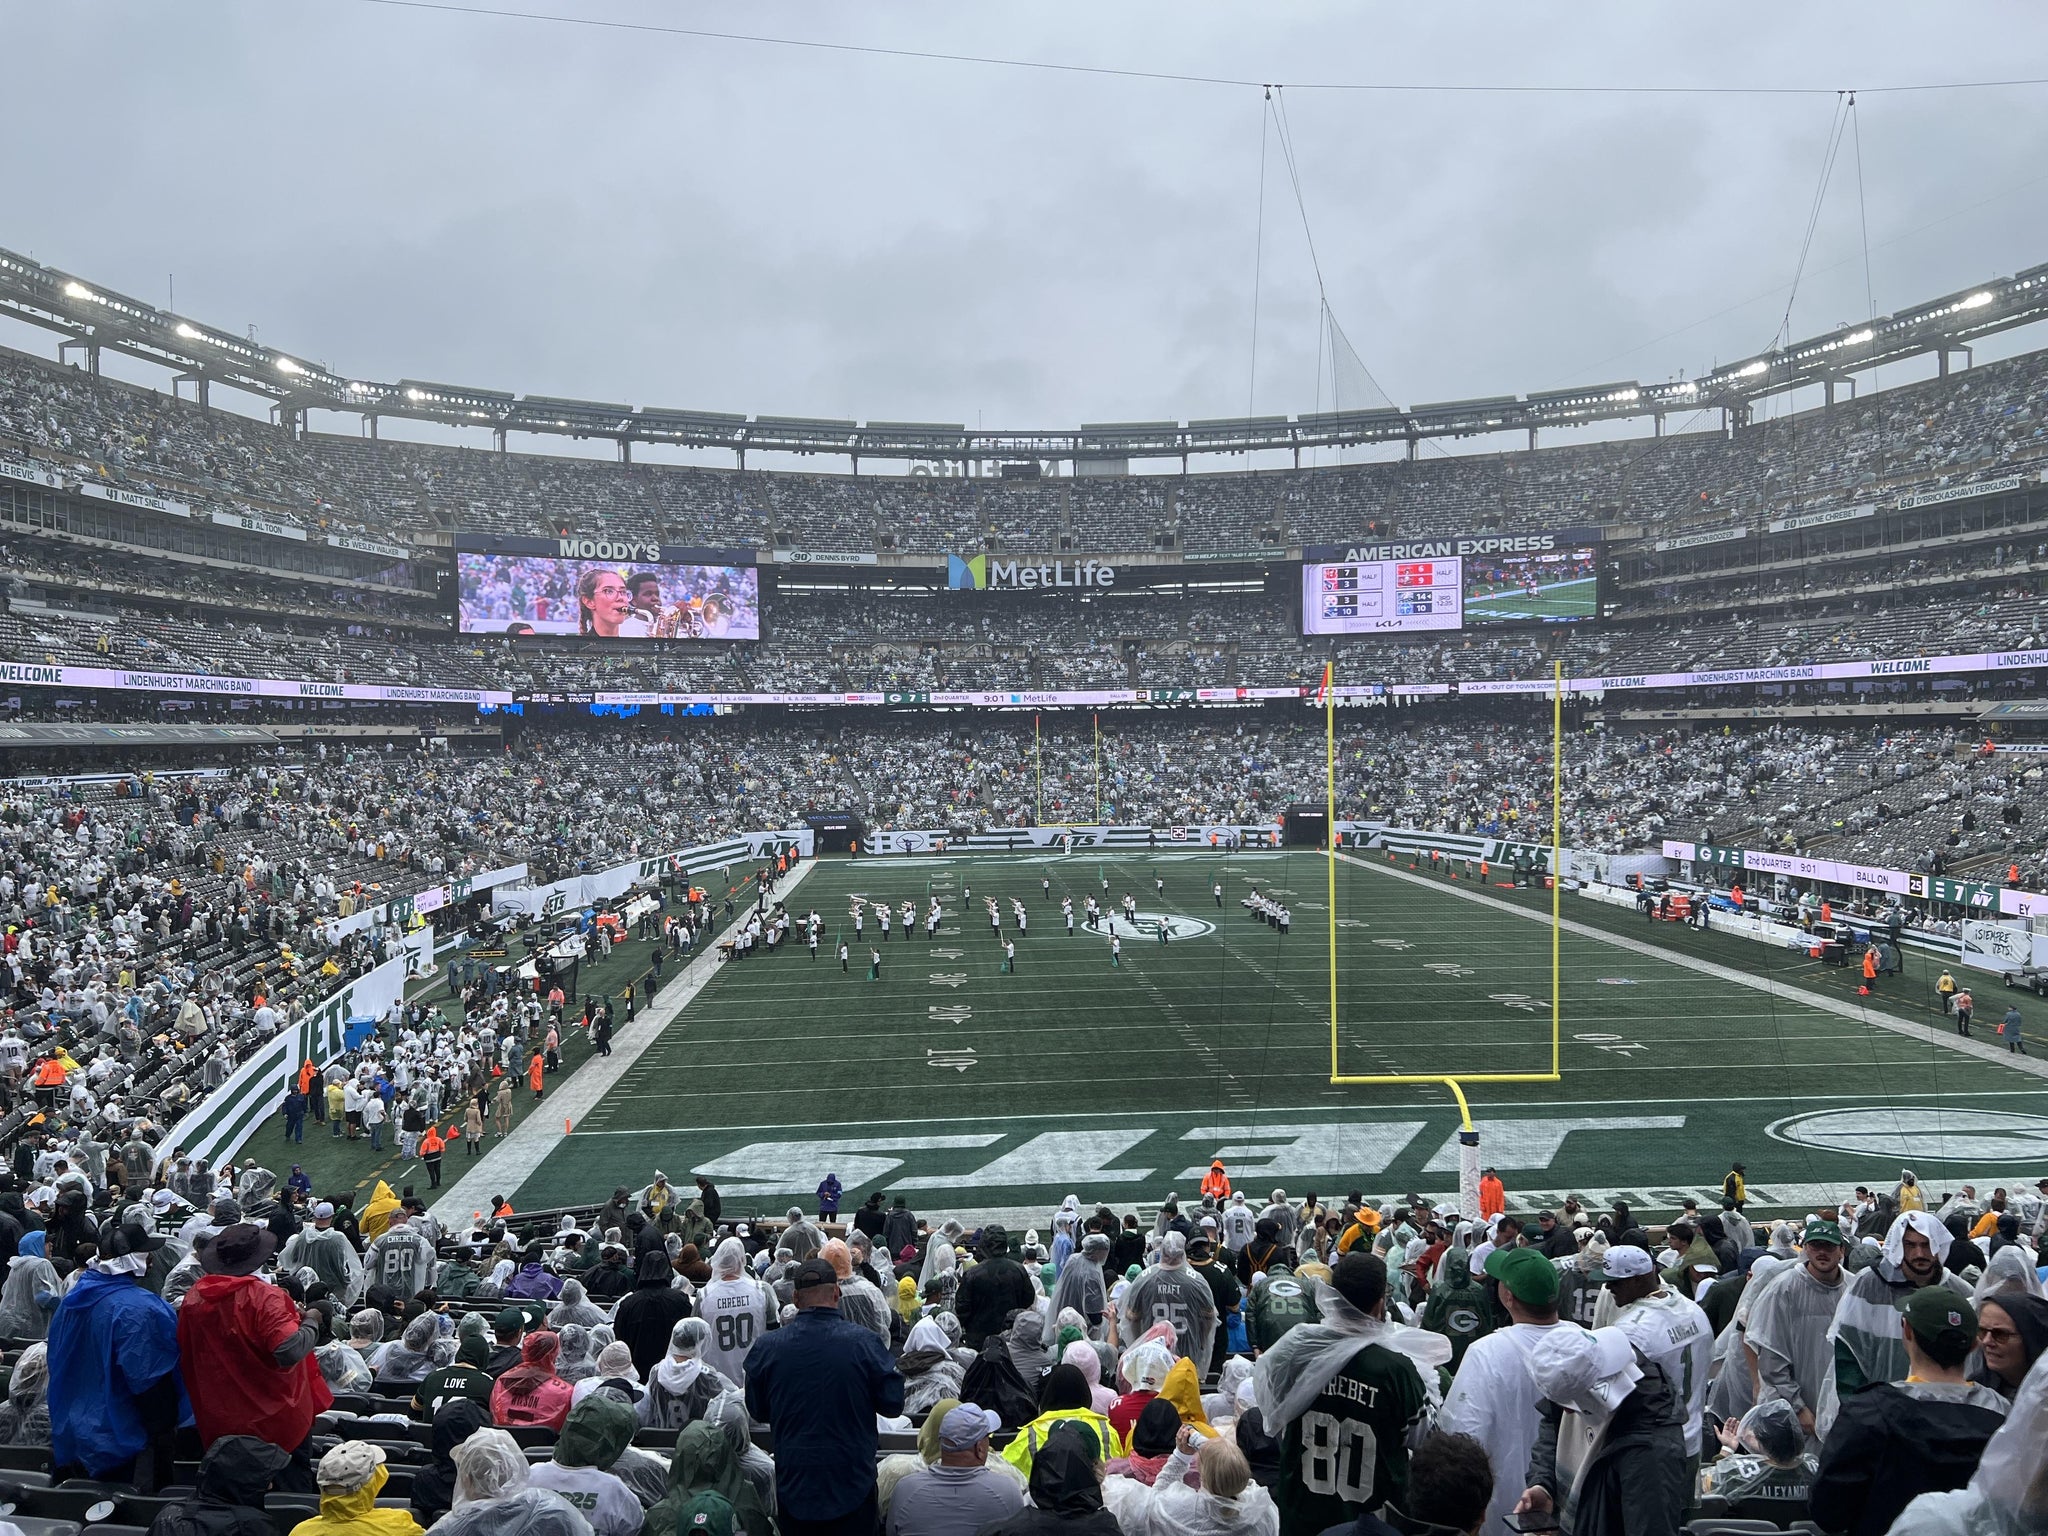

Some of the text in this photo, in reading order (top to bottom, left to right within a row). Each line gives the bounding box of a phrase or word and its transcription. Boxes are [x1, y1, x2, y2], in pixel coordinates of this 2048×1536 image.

[11, 467, 34, 481] REVIS
[106, 488, 166, 511] 41 MATT SNELL
[1900, 478, 2018, 509] 60 D'BRICKASHAW FERGUSON
[240, 518, 282, 534] 88 AL TOON
[1784, 508, 1857, 530] 80 WAYNE CHREBET
[338, 538, 399, 556] 85 WESLEY WALKER
[1666, 530, 1734, 549] 32 EMERSON BOOZER
[559, 539, 661, 562] MOODY'S
[1344, 535, 1554, 562] AMERICAN EXPRESS
[794, 553, 860, 562] 90 DENNIS BYRD
[992, 559, 1114, 588] MetLife
[0, 664, 62, 683] WELCOME
[1870, 660, 1931, 674] WELCOME
[124, 674, 252, 692] LINDENHURST MARCHING BAND
[1601, 677, 1646, 688] WELCOME
[1692, 668, 1813, 684] LINDENHURST MARCHING BAND
[300, 684, 344, 696] WELCOME
[386, 688, 480, 700] LINDENHURST MARCHING BAND
[1023, 694, 1058, 703] MetLife
[20, 778, 44, 786] YORK
[1173, 829, 1185, 840] 25
[1674, 850, 1682, 858] EY
[1718, 850, 1727, 863] 7
[639, 857, 681, 878] JET
[1748, 855, 1792, 870] 2nd QUARTER
[1800, 863, 1816, 874] 9:01
[1856, 871, 1889, 886] BALL ON
[1910, 879, 1922, 891] 25
[1954, 885, 1964, 901] 7
[2019, 903, 2031, 915] EY
[1488, 993, 1553, 1008] 20
[928, 1004, 972, 1020] 20
[1572, 1033, 1650, 1052] 10
[7, 1046, 17, 1058] 10
[927, 1046, 978, 1066] 10
[1235, 1219, 1244, 1233] 2
[384, 1248, 413, 1274] 80
[1157, 1282, 1182, 1296] KRAFT
[717, 1294, 750, 1310] CHREBET
[1572, 1288, 1600, 1322] 12
[1151, 1302, 1190, 1336] 85
[715, 1312, 754, 1352] 80
[1680, 1342, 1692, 1403] 1
[444, 1377, 468, 1389] LOVE
[1321, 1374, 1380, 1409] REBET
[511, 1395, 540, 1410] WILSON
[1301, 1410, 1377, 1504] 80
